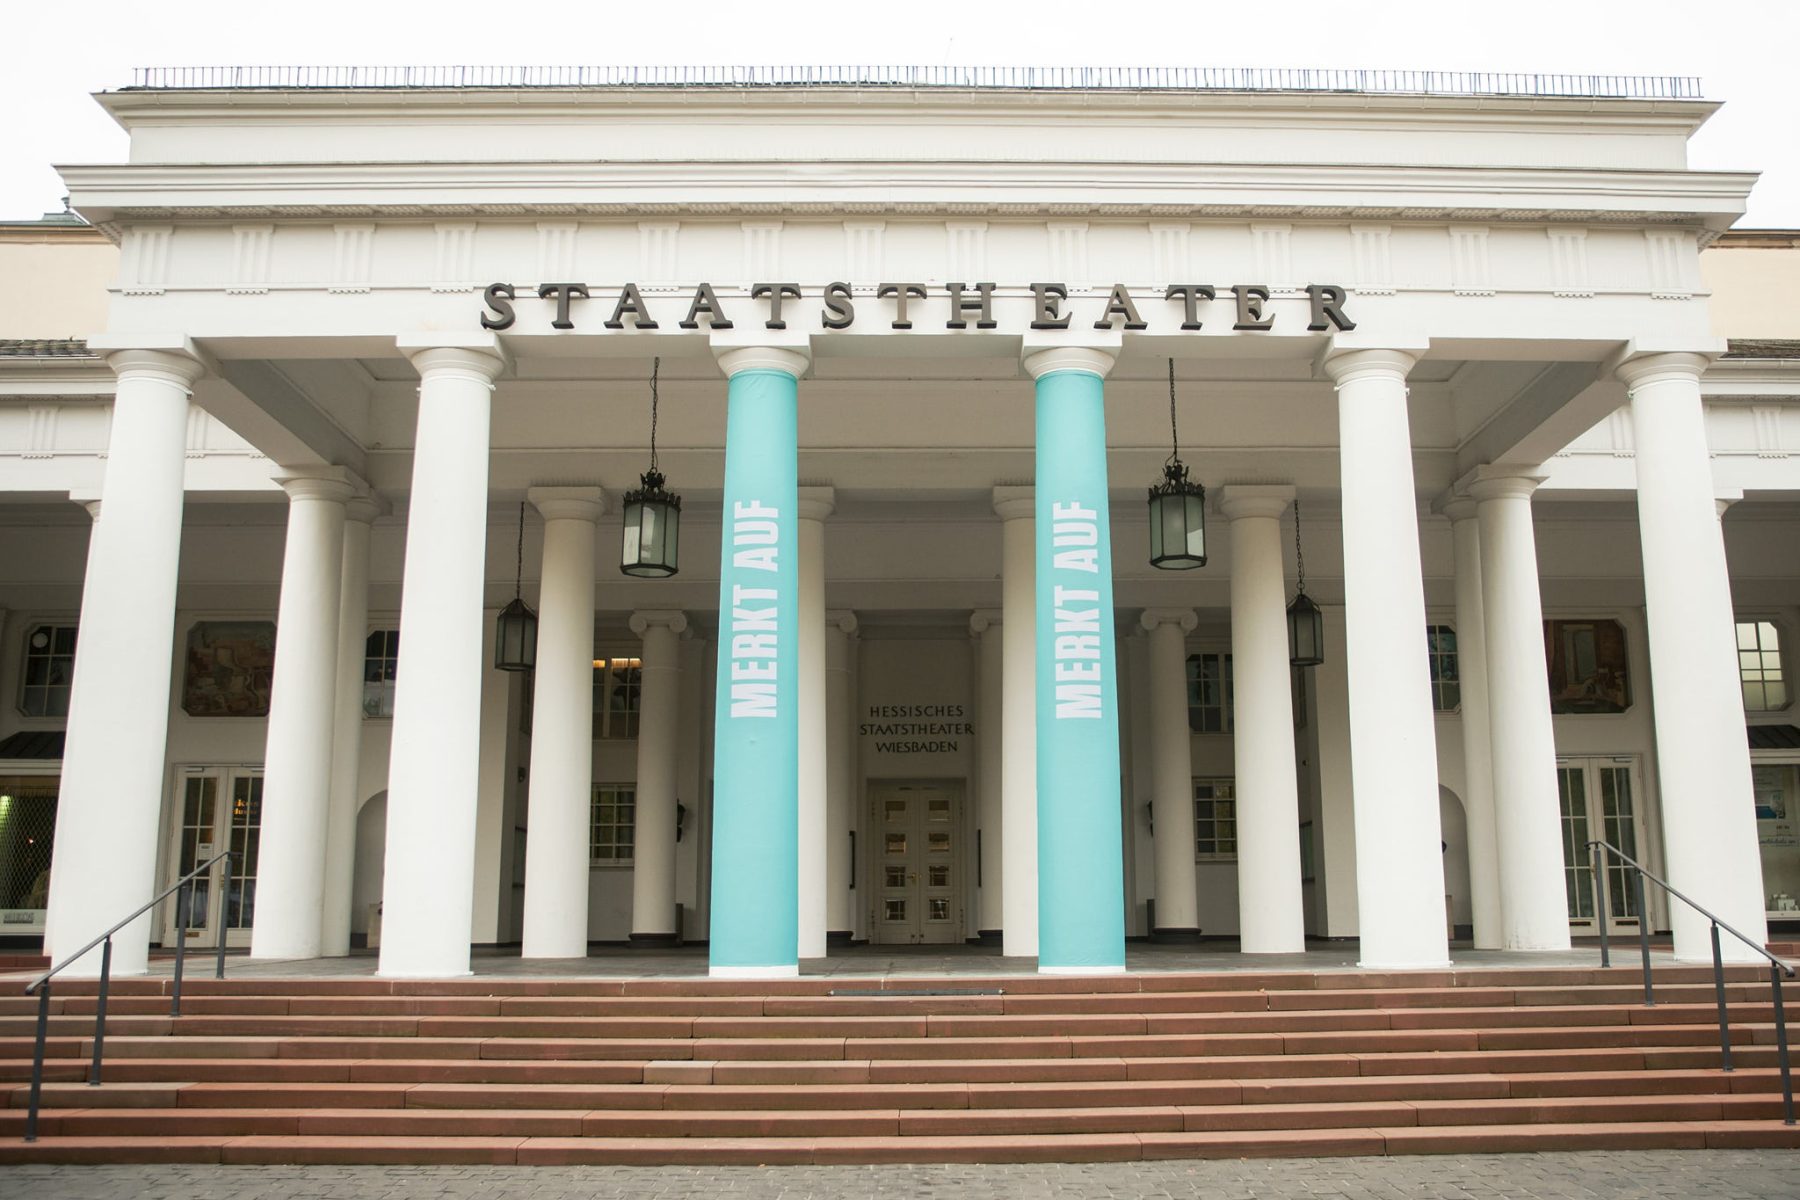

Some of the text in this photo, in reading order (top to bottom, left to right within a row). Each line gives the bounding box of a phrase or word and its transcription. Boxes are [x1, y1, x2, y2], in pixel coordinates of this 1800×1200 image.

[480, 282, 1357, 331] STAATSTHEATER
[730, 499, 779, 718] MERKT AUF
[1052, 501, 1103, 719] MERKT AUF
[869, 705, 964, 718] HESSISCHES
[859, 723, 976, 736] STAATSTHEATER
[875, 741, 958, 753] WIESBADEN
